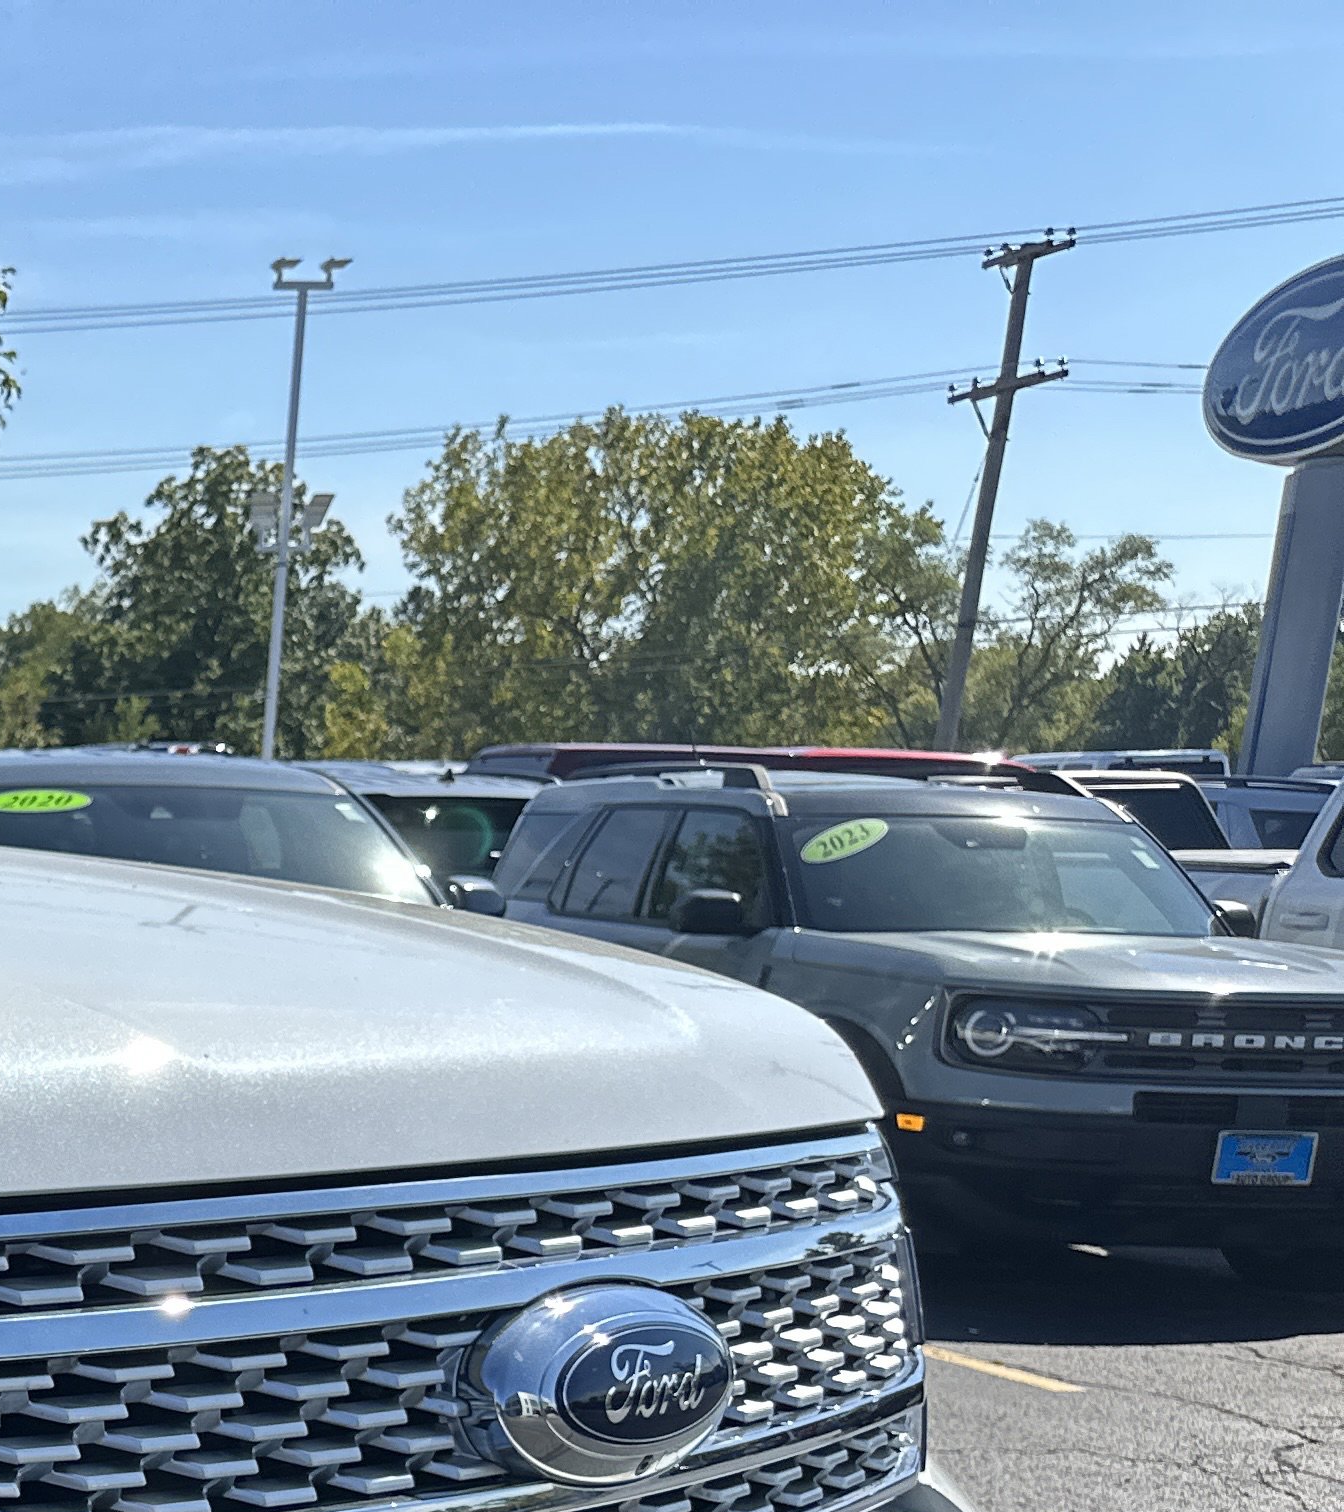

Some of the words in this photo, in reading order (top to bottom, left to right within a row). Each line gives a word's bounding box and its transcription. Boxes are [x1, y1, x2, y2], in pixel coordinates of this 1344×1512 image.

[1, 795, 73, 809] 2020
[816, 824, 870, 858] 2023
[605, 1340, 705, 1424] Ford
